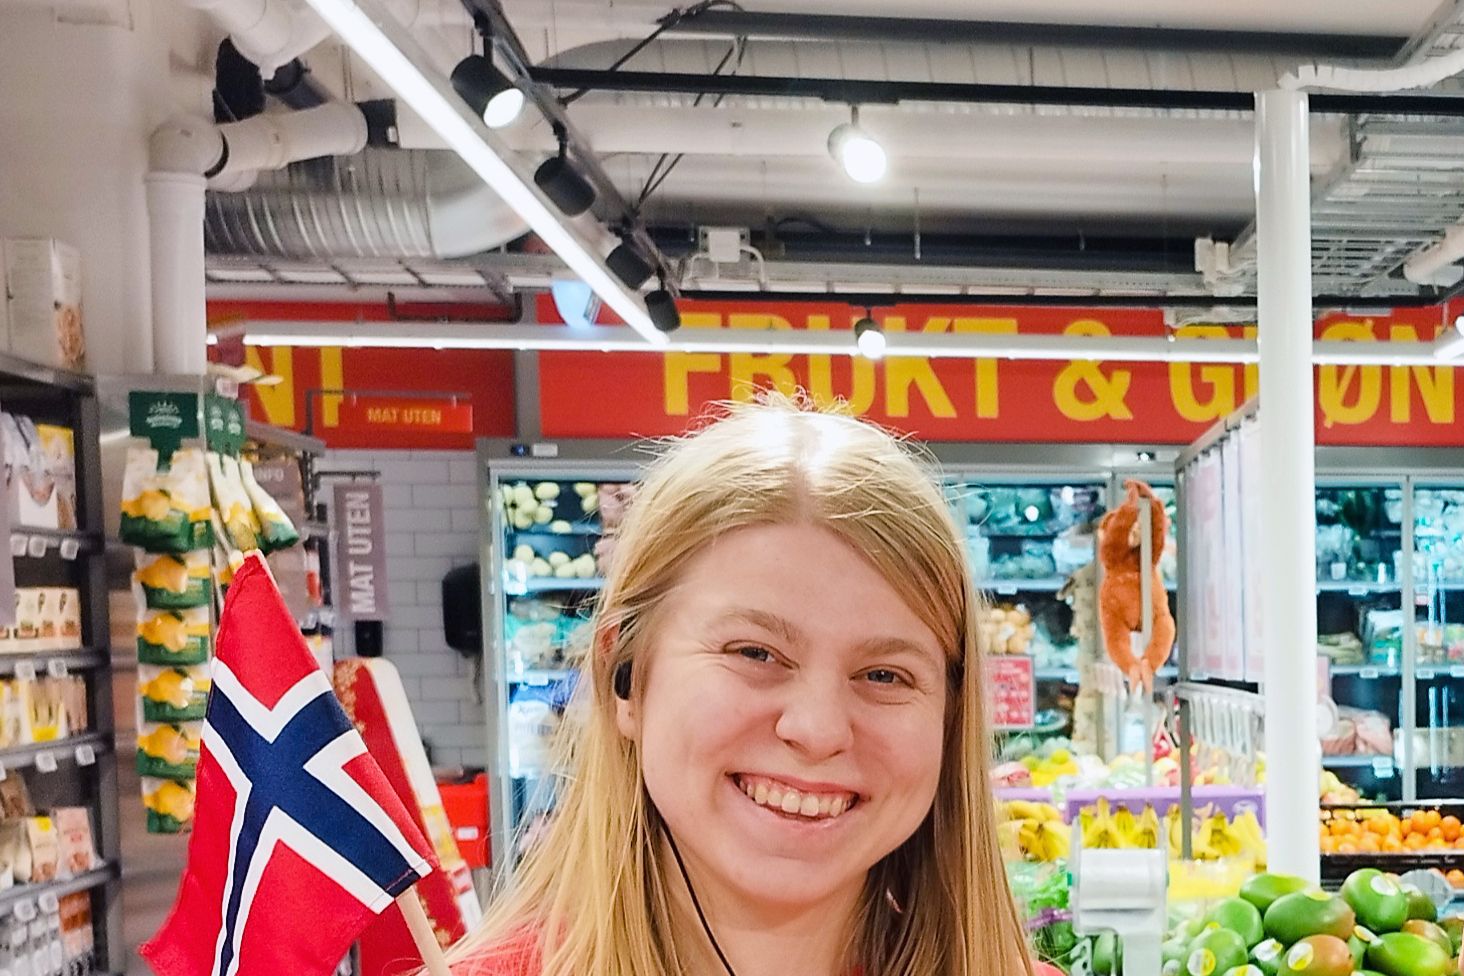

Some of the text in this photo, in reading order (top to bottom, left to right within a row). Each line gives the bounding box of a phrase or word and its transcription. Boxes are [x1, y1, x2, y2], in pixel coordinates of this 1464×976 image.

[367, 408, 442, 424] MAT UTEN
[663, 312, 1018, 419] FRUKT
[1053, 318, 1133, 421] &
[345, 492, 377, 614] MAT UTEN
